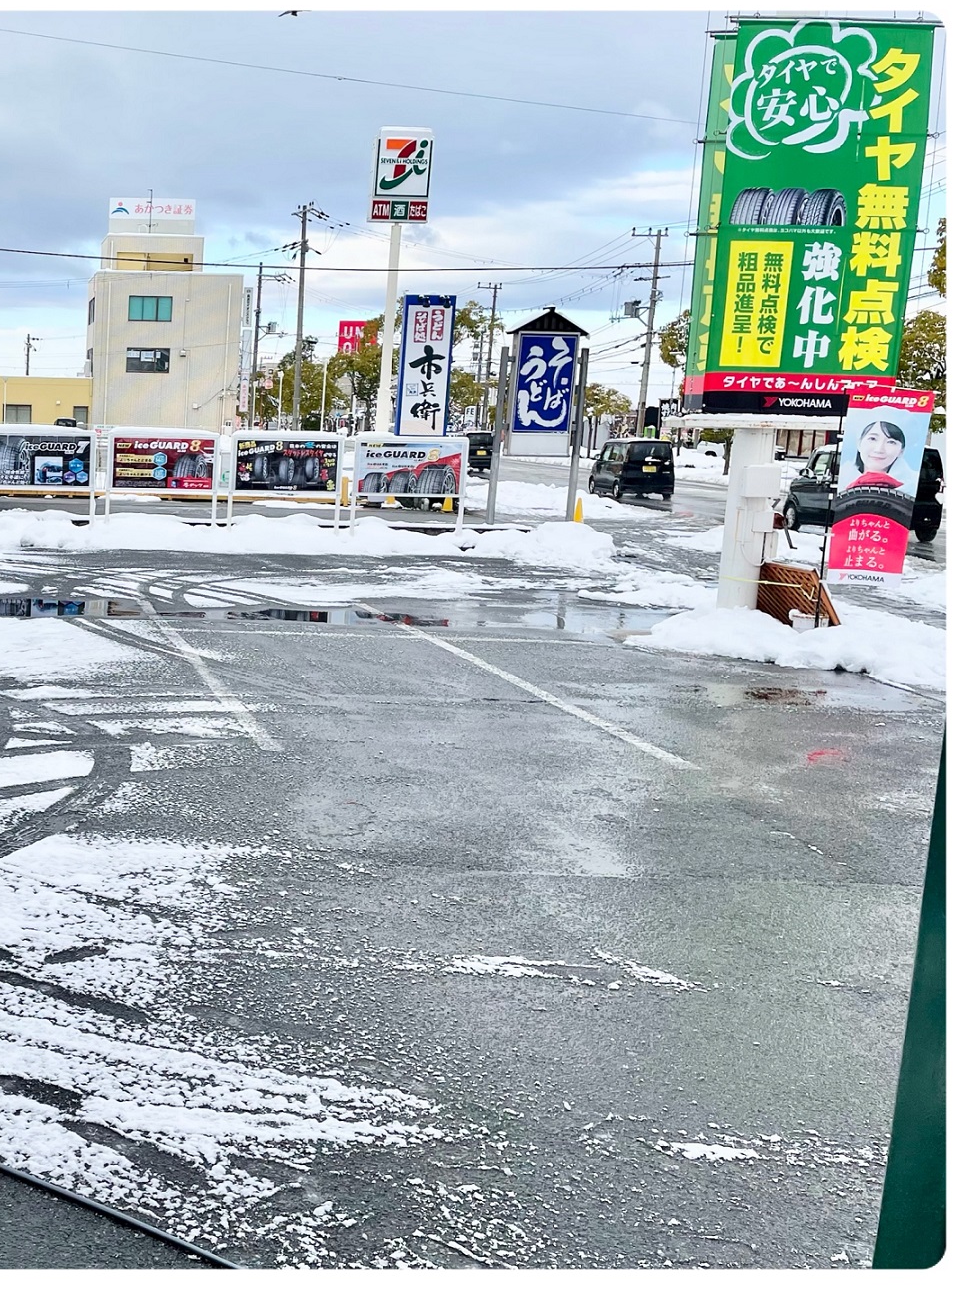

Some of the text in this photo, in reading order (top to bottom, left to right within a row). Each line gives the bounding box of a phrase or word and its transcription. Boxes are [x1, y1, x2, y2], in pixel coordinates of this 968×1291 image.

[758, 58, 838, 89] タイヤで
[757, 85, 840, 131] 安心
[134, 204, 193, 215] あかつき証券
[372, 203, 390, 216] ATM
[393, 204, 407, 217] 酒
[409, 204, 427, 217] たばこ
[838, 47, 921, 372] タイヤ無料点検
[757, 252, 784, 355] 無料点検で
[793, 241, 843, 369] 強化中
[778, 397, 832, 409] YOKOHAMA
[865, 394, 917, 405] iceGUARD
[917, 395, 930, 408] 8
[25, 441, 91, 454] iceGUARD 7
[133, 441, 189, 450] iceGUARD
[189, 440, 201, 452] 8
[238, 441, 284, 457] iceGUARD 8
[365, 450, 426, 459] iceGUARD
[849, 519, 890, 529] よりちゃんと
[847, 529, 888, 543] 曲がる。
[843, 555, 884, 569] 止まる。
[847, 573, 885, 583] YOKOHAMA
